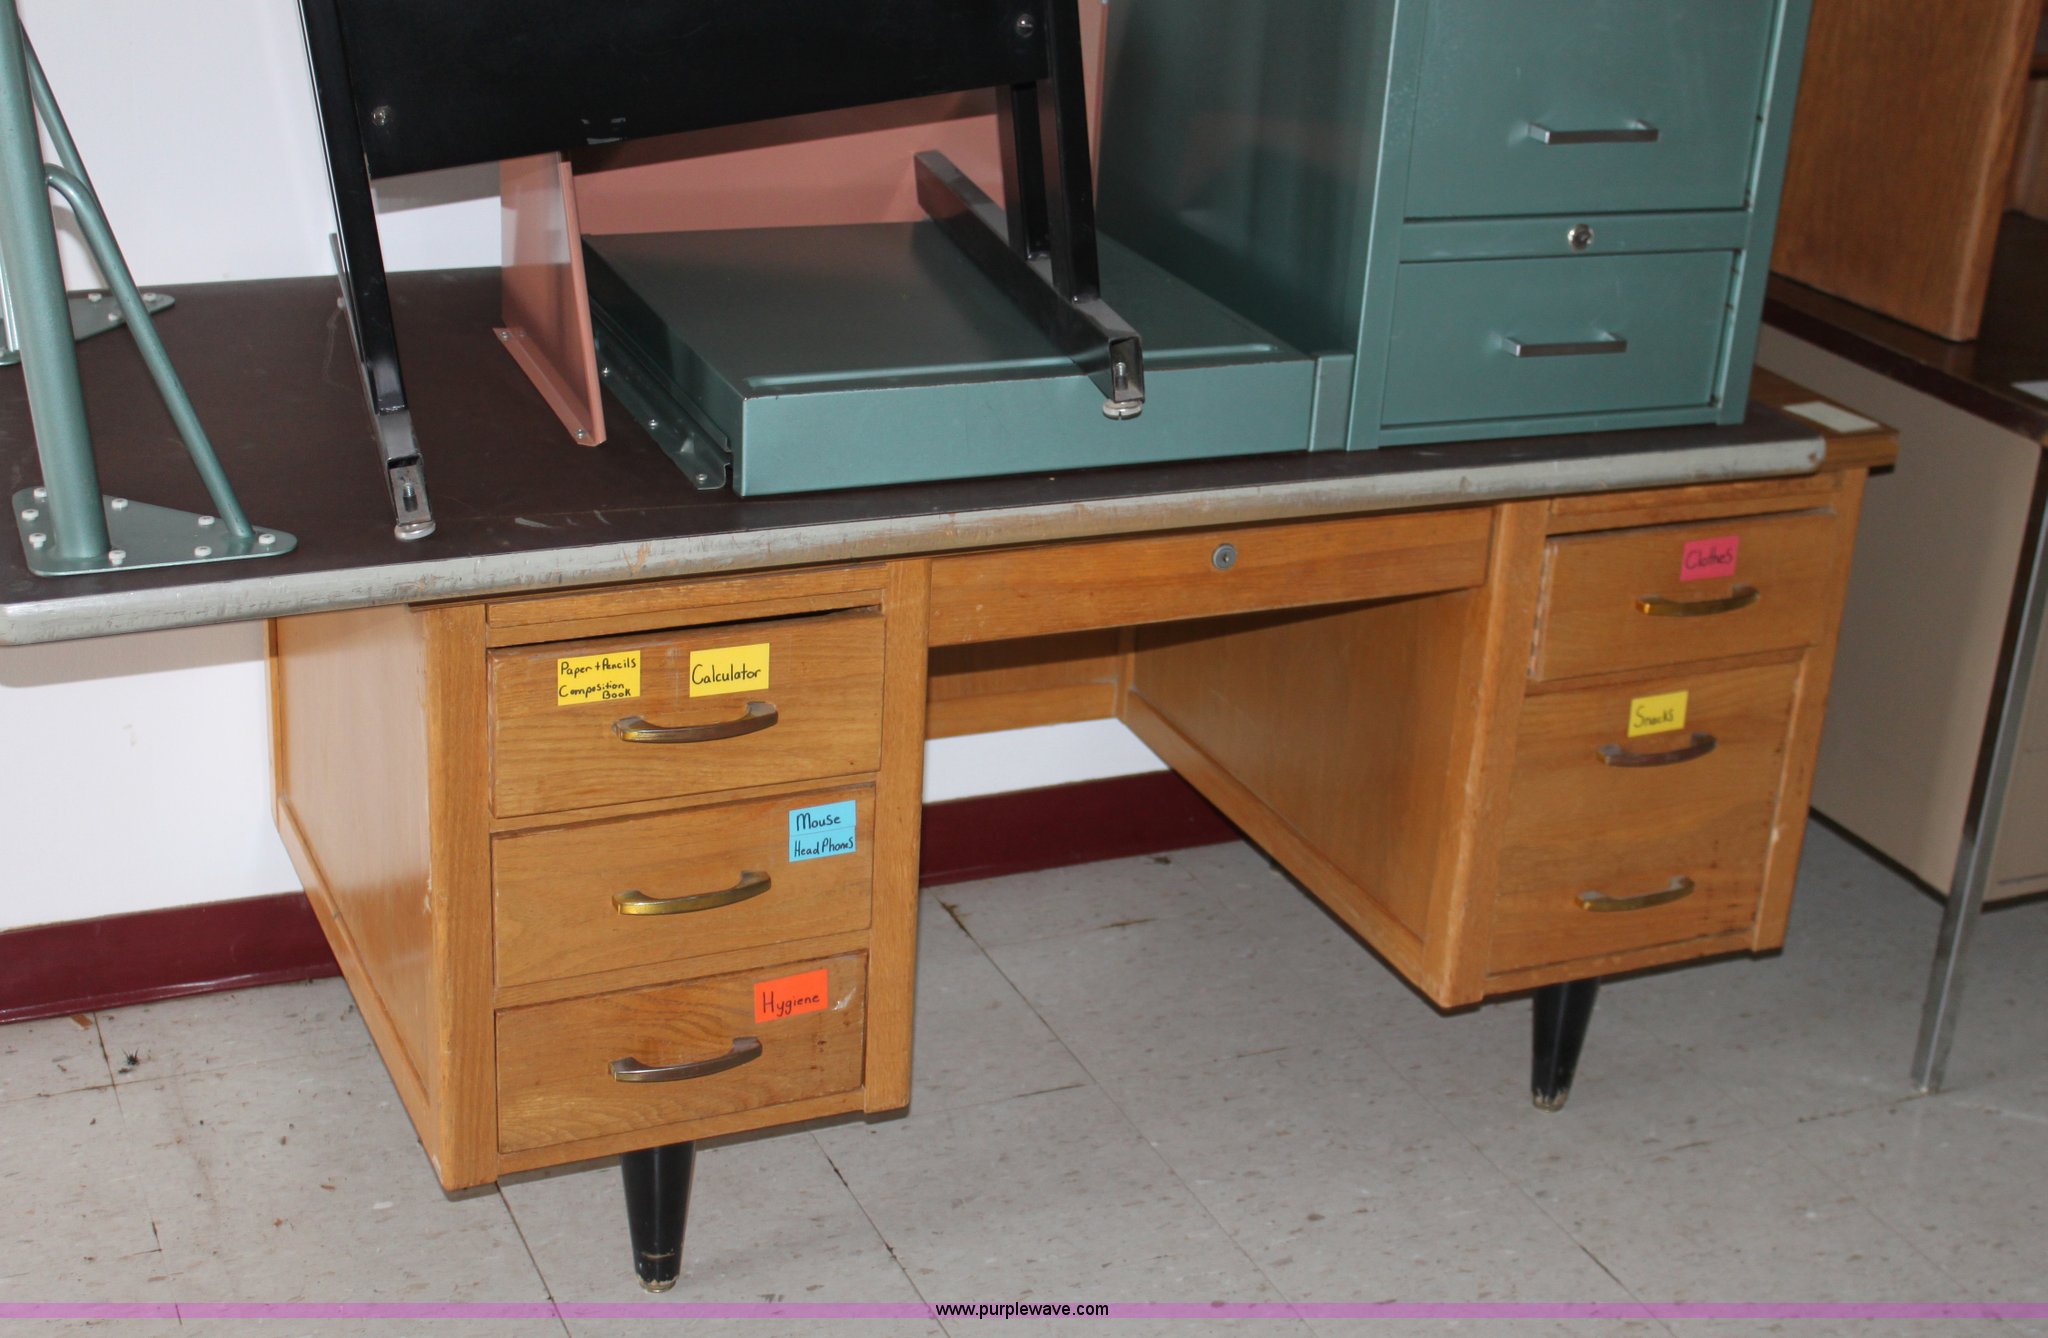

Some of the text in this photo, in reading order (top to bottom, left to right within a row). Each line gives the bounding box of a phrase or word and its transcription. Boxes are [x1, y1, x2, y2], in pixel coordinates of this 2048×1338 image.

[560, 662, 592, 678] Paper
[691, 663, 761, 685] Calculator
[558, 681, 625, 698] Composition
[602, 689, 632, 700] Book
[1634, 706, 1675, 729] Snacks
[796, 812, 841, 831] Mouse
[762, 991, 820, 1017] Hygiene
